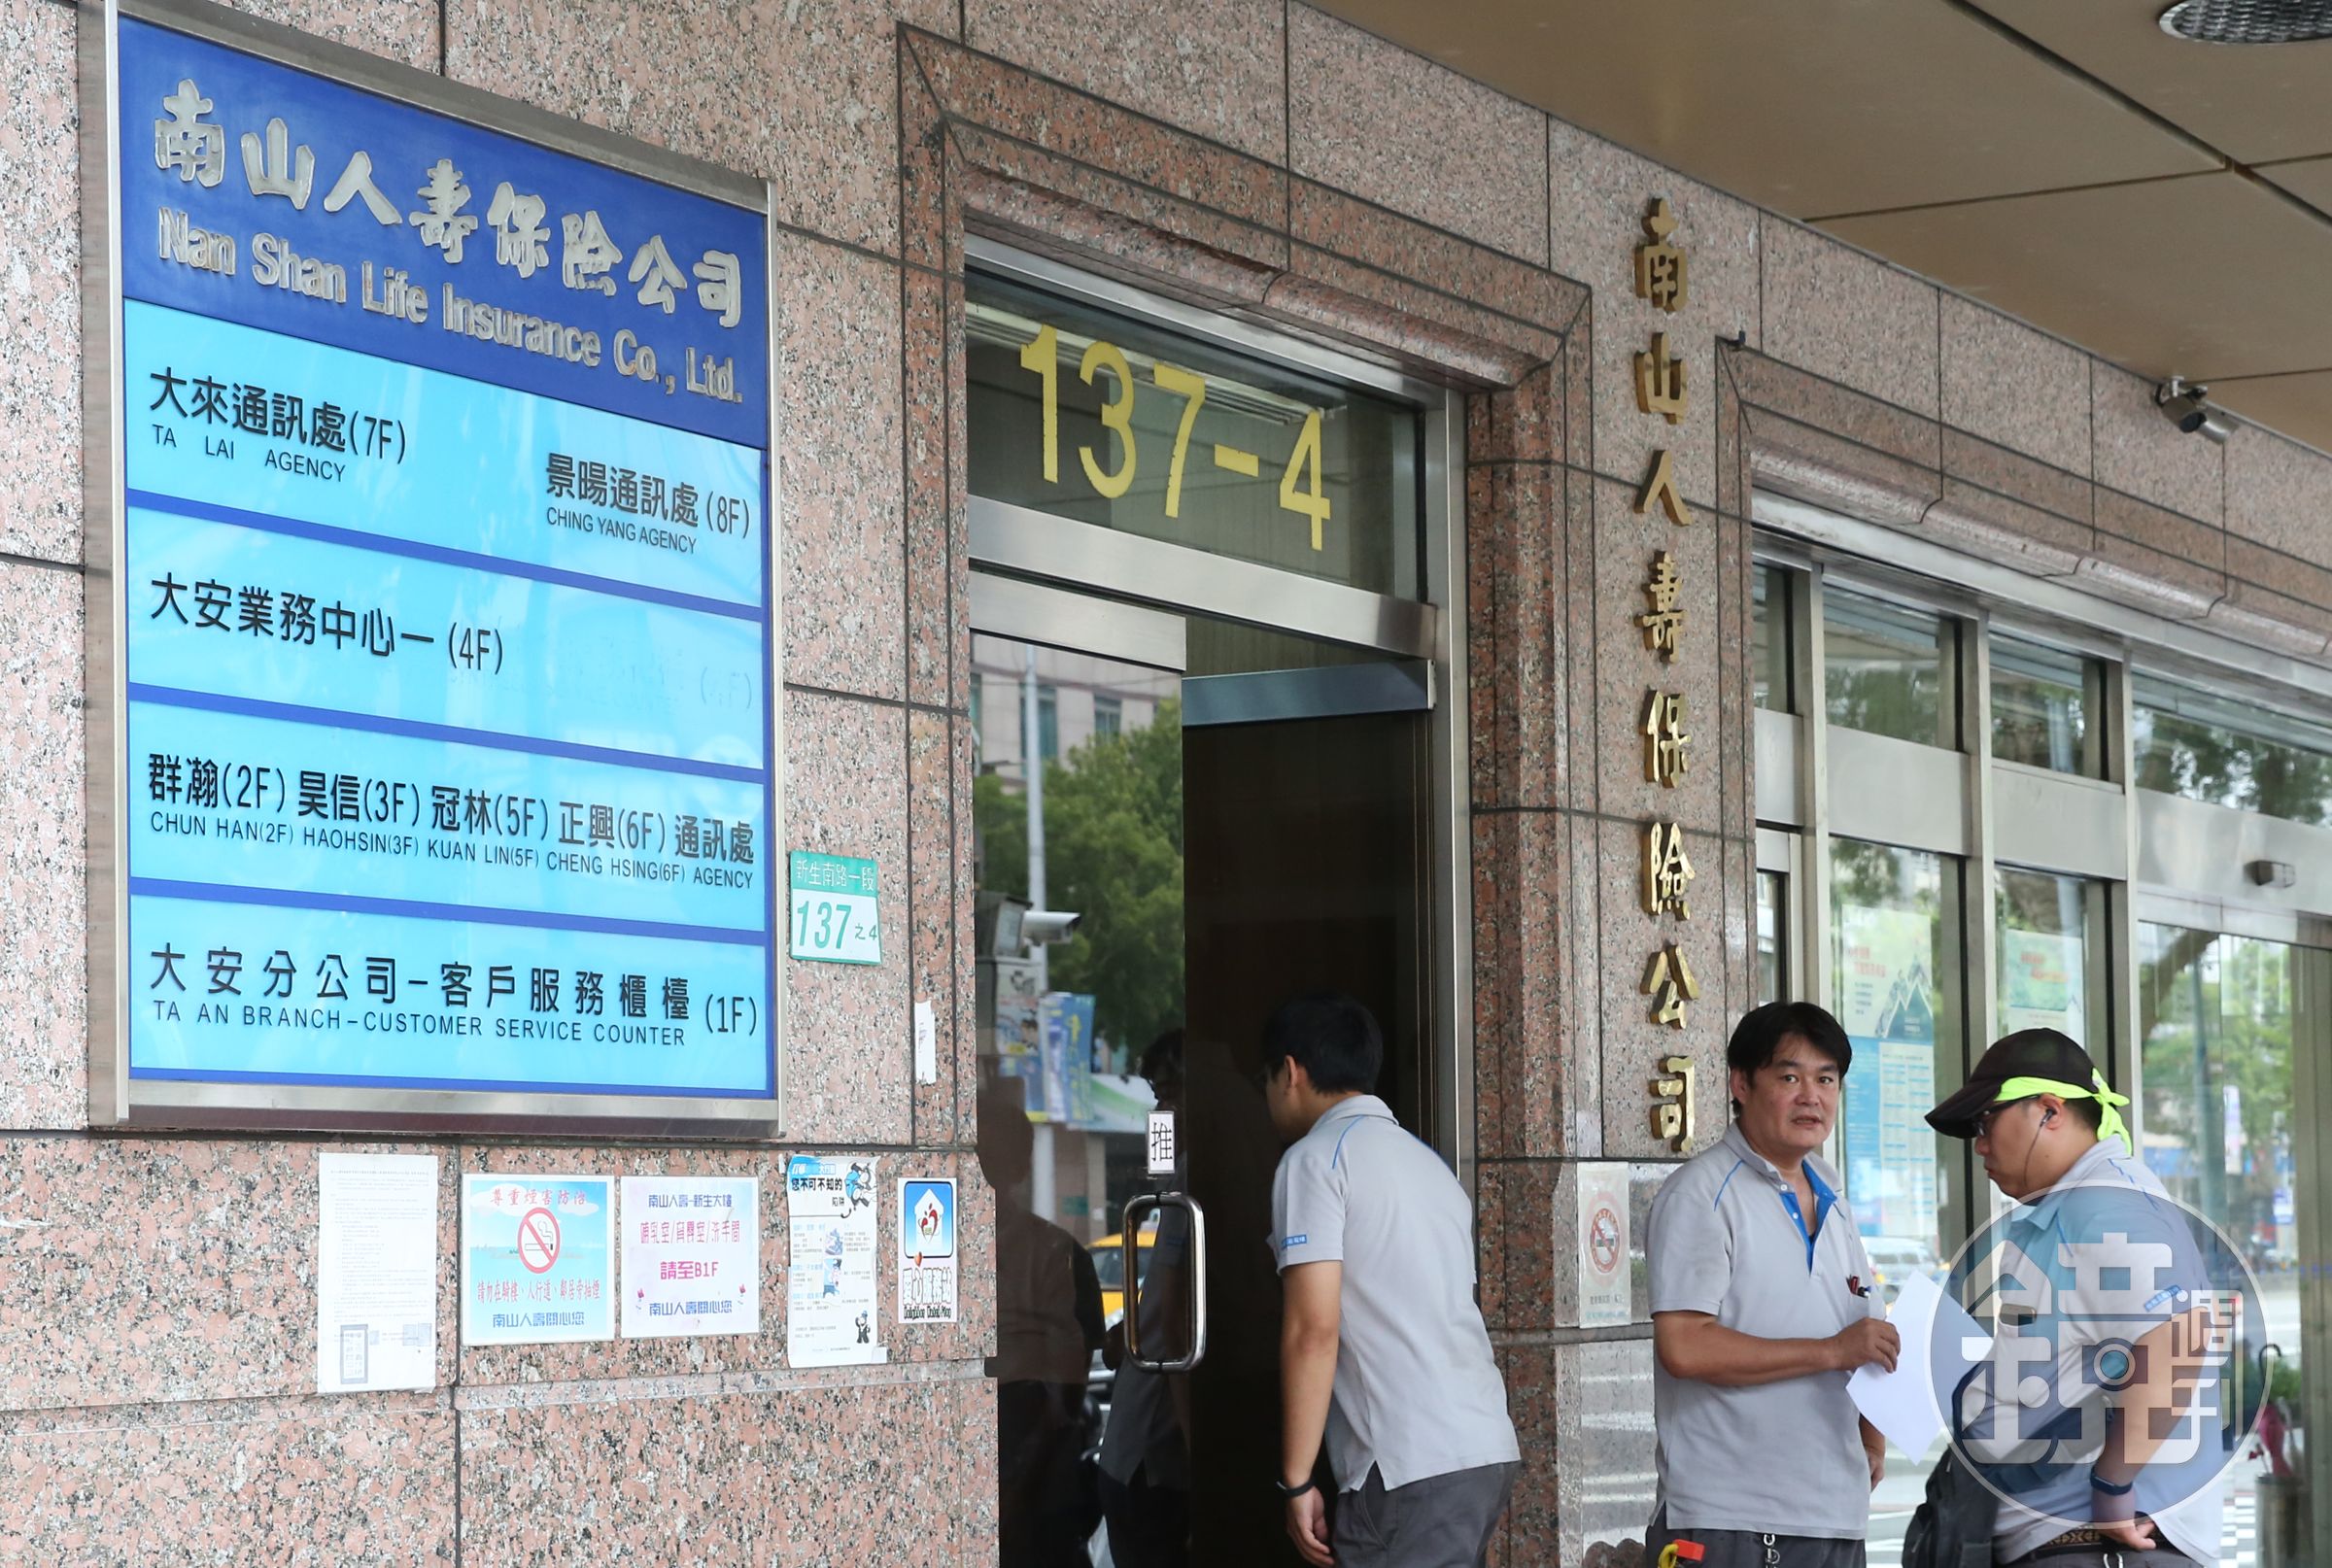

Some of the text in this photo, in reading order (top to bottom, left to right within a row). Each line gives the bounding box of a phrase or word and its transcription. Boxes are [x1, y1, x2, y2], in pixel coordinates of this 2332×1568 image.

[154, 78, 742, 328] 南山人壽保險公司
[158, 205, 742, 403] Nan Shan Life Insurance Co., Ltd.
[152, 424, 346, 482] TA LAI AGENCY
[1020, 324, 1331, 552] 137-4
[547, 506, 697, 554] CHING YANG AGENCY
[1633, 197, 1699, 1153] 南山人壽保險公司
[151, 811, 206, 835] CHUN
[217, 818, 293, 845] HAN(2F)
[428, 838, 476, 863] KUAN
[547, 851, 602, 874] CHENG
[611, 858, 685, 884] HSING(6F)
[693, 867, 753, 889] AGENCY
[674, 814, 754, 865] 通訊處
[796, 859, 875, 892] 新生南路一段
[153, 1000, 181, 1022] TA
[197, 1003, 229, 1025] AN
[496, 1018, 582, 1041] SERVICE
[594, 1023, 685, 1046] COUNTER
[1150, 1121, 1173, 1163] 推
[791, 1177, 842, 1192] 您不可不知的
[660, 1260, 719, 1280] 請至B1F
[492, 1312, 586, 1328] 南山人壽關心您
[649, 1300, 733, 1316] 南山人壽關心您
